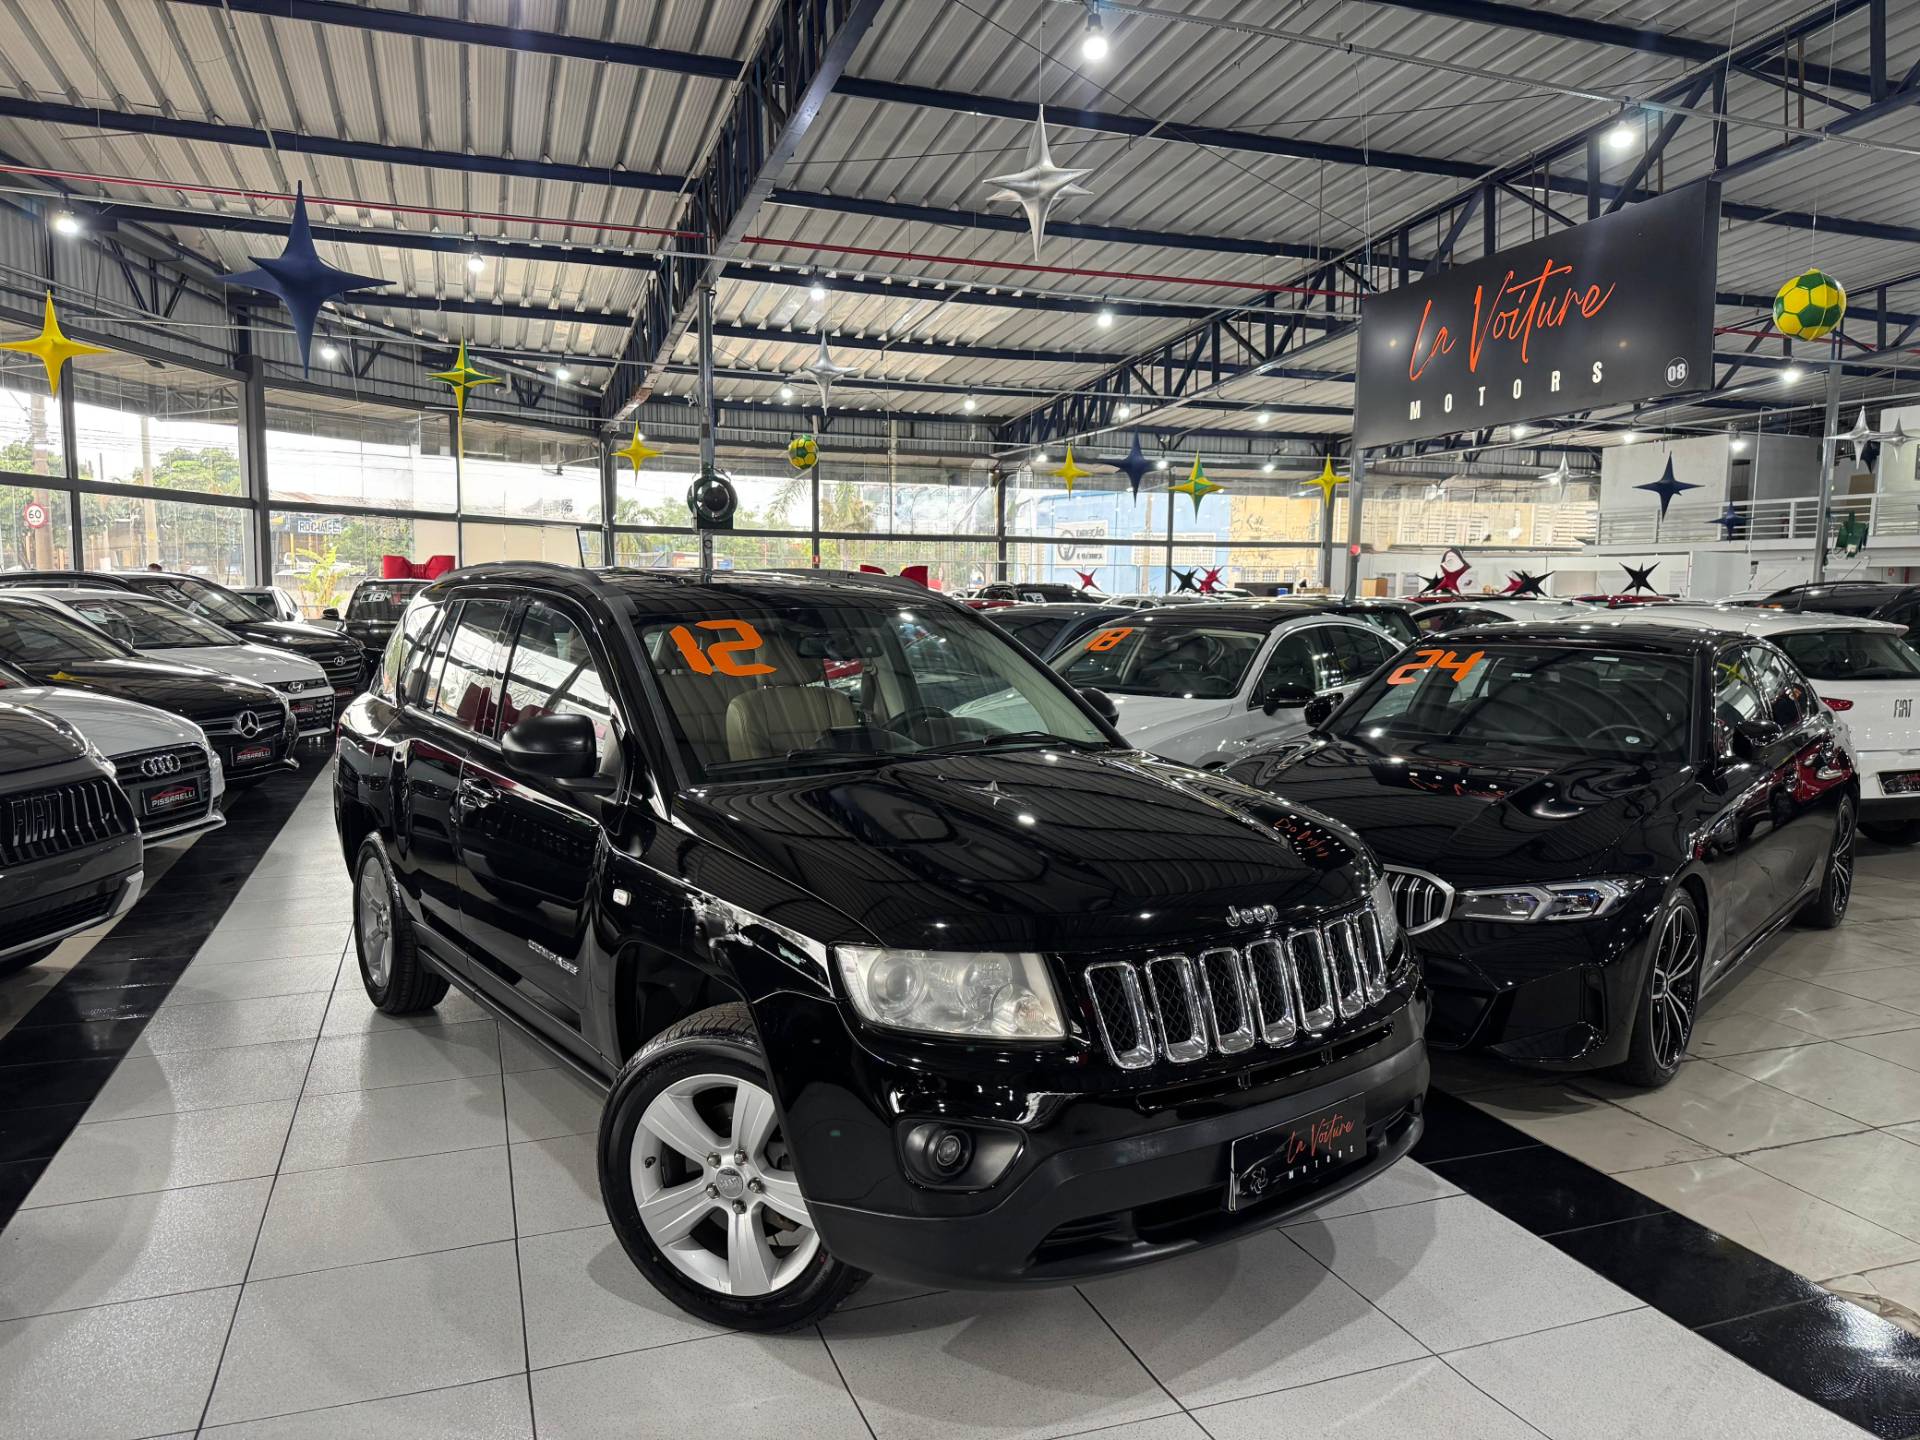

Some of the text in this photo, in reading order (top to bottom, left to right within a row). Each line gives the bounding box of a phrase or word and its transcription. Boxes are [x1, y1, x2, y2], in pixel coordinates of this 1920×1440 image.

[1409, 259, 1616, 382] La Voiture
[1667, 363, 1687, 382] 08
[1409, 361, 1603, 420] MOTORS
[28, 509, 42, 519] 60
[669, 619, 777, 676] 12
[1084, 627, 1133, 652] 18
[1386, 649, 1485, 684] 24
[1893, 698, 1913, 718] FIAT
[151, 788, 196, 808] PISSARELLI
[9, 793, 58, 847] FIAT
[1225, 904, 1279, 927] Jeep
[1287, 1113, 1355, 1164] La Voiture
